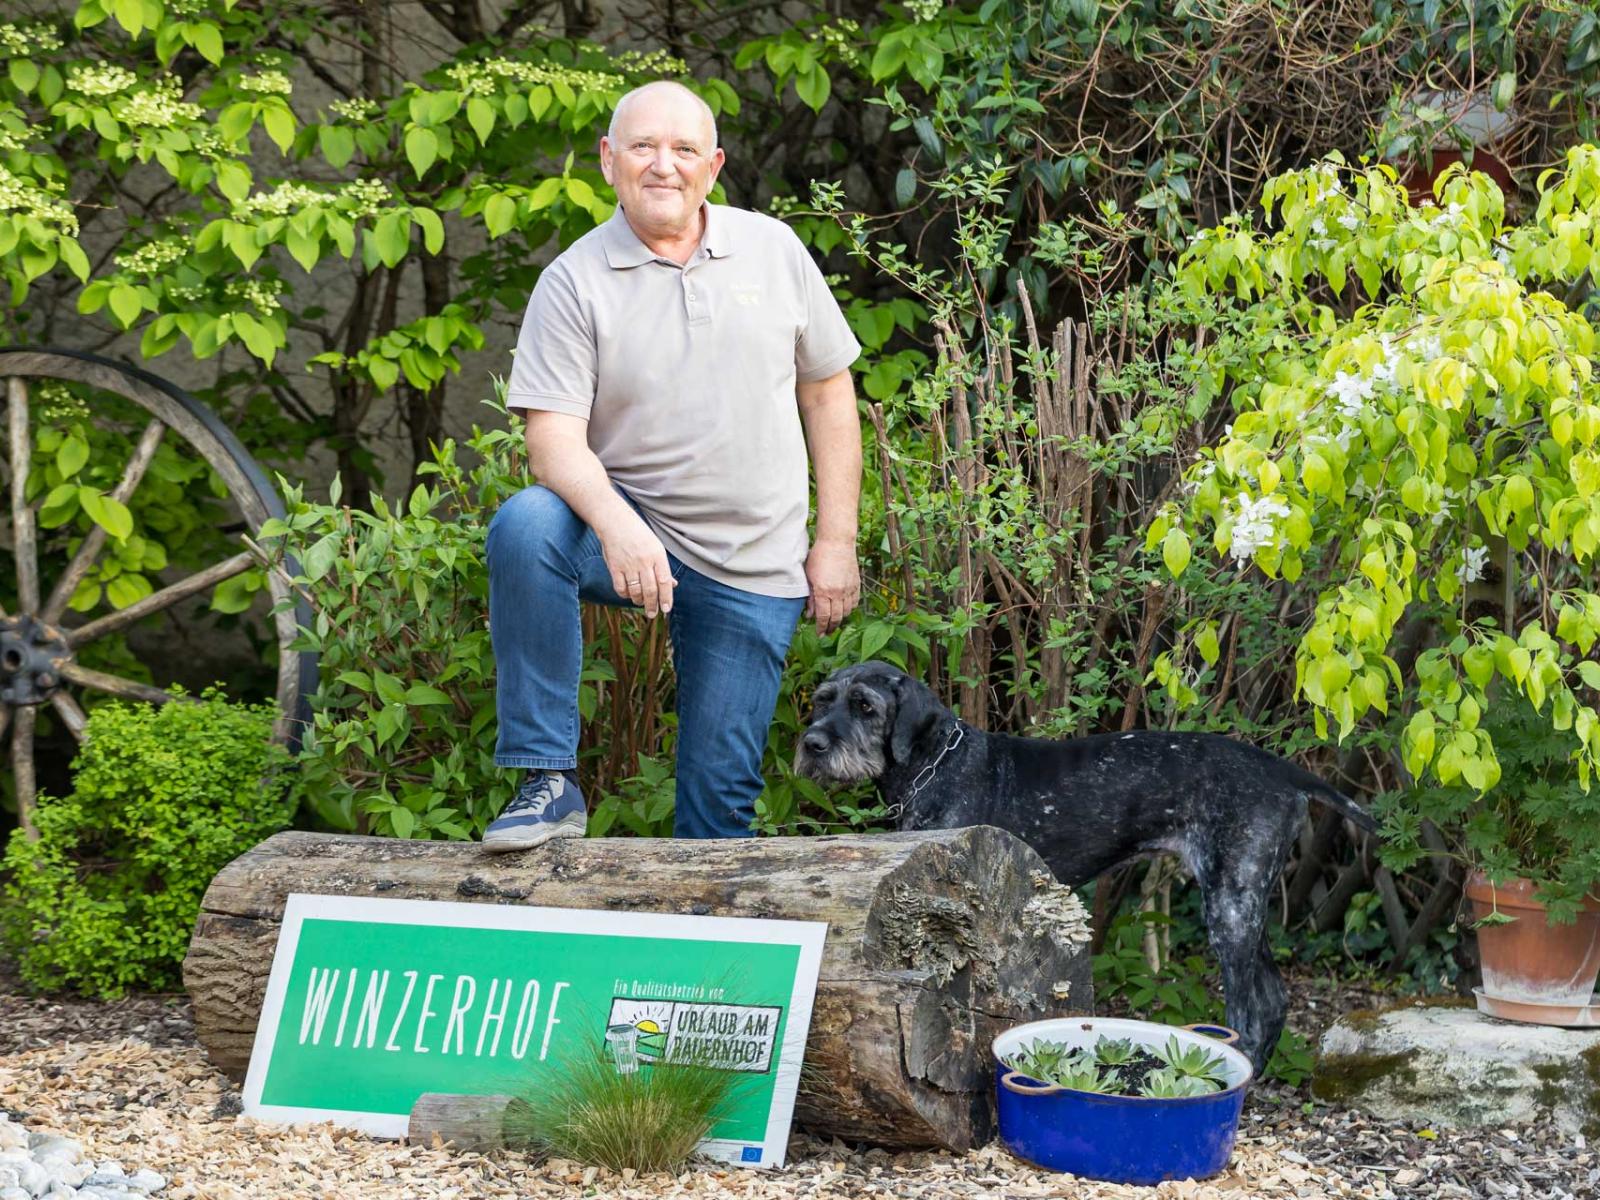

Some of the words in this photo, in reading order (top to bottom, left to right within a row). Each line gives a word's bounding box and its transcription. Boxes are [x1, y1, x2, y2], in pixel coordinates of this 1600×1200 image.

[613, 978, 628, 995] Ein
[631, 979, 705, 999] Qualitätsbetrieb
[709, 988, 725, 1000] von
[298, 967, 570, 1061] WINZERHOF
[677, 1010, 738, 1036] URLAUB
[742, 1013, 769, 1037] AM
[672, 1036, 767, 1064] BAUERNHOF
